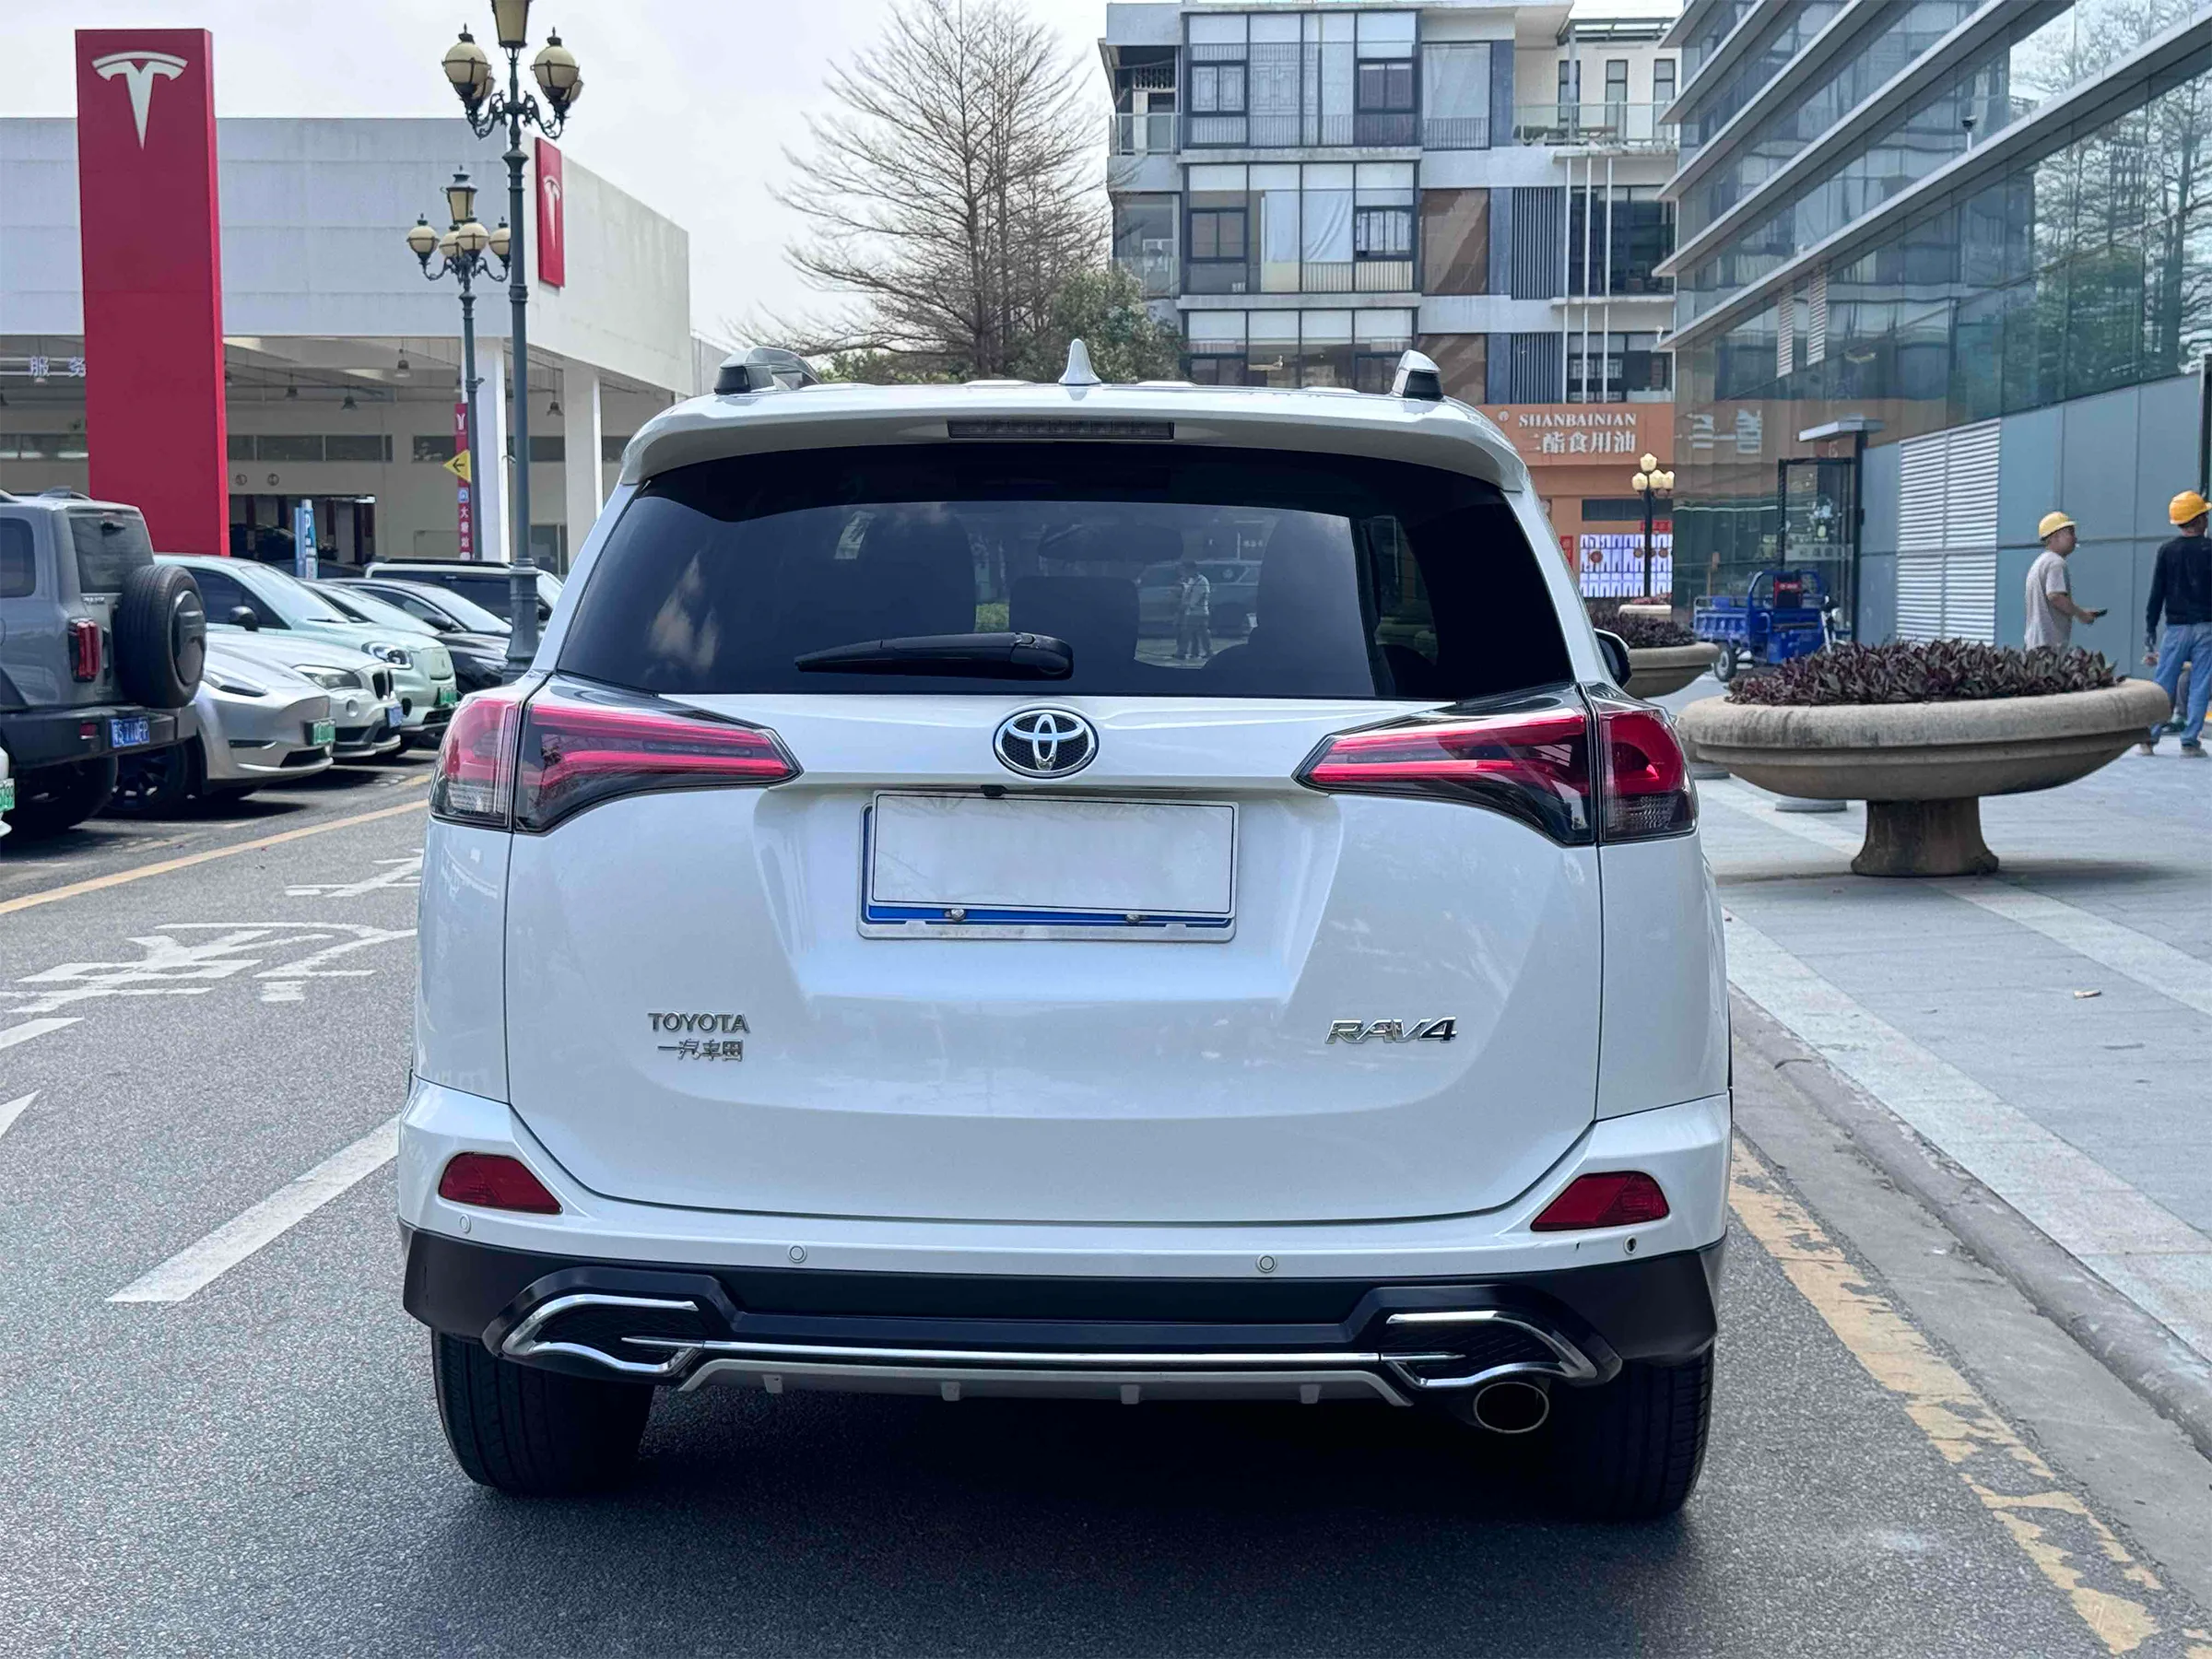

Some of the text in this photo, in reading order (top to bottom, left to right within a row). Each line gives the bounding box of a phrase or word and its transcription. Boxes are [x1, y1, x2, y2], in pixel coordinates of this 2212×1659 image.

[1519, 413, 1637, 428] SHANBAINIAN
[647, 1012, 751, 1033] TOYOTA
[1324, 1016, 1458, 1044] RAV4
